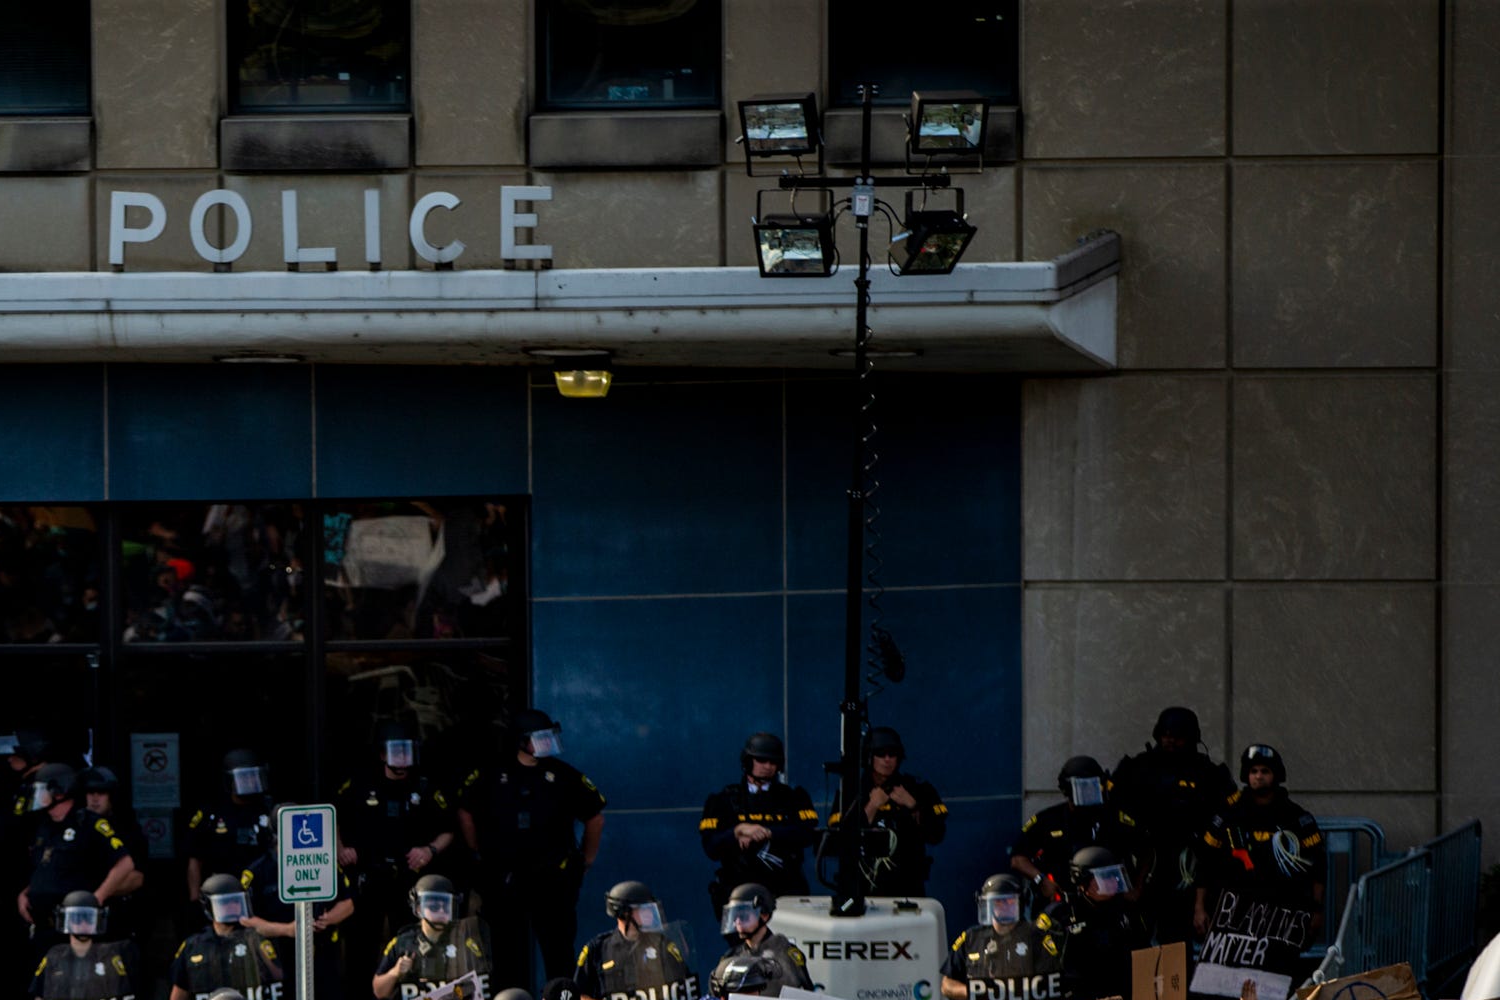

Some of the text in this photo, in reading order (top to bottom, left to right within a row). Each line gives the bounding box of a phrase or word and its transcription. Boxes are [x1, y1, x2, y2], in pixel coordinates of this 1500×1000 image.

[108, 185, 553, 265] POLICE
[286, 853, 330, 867] PARKING
[295, 869, 321, 882] ONLY
[803, 941, 913, 960] TEREX
[1201, 931, 1269, 966] MATTER
